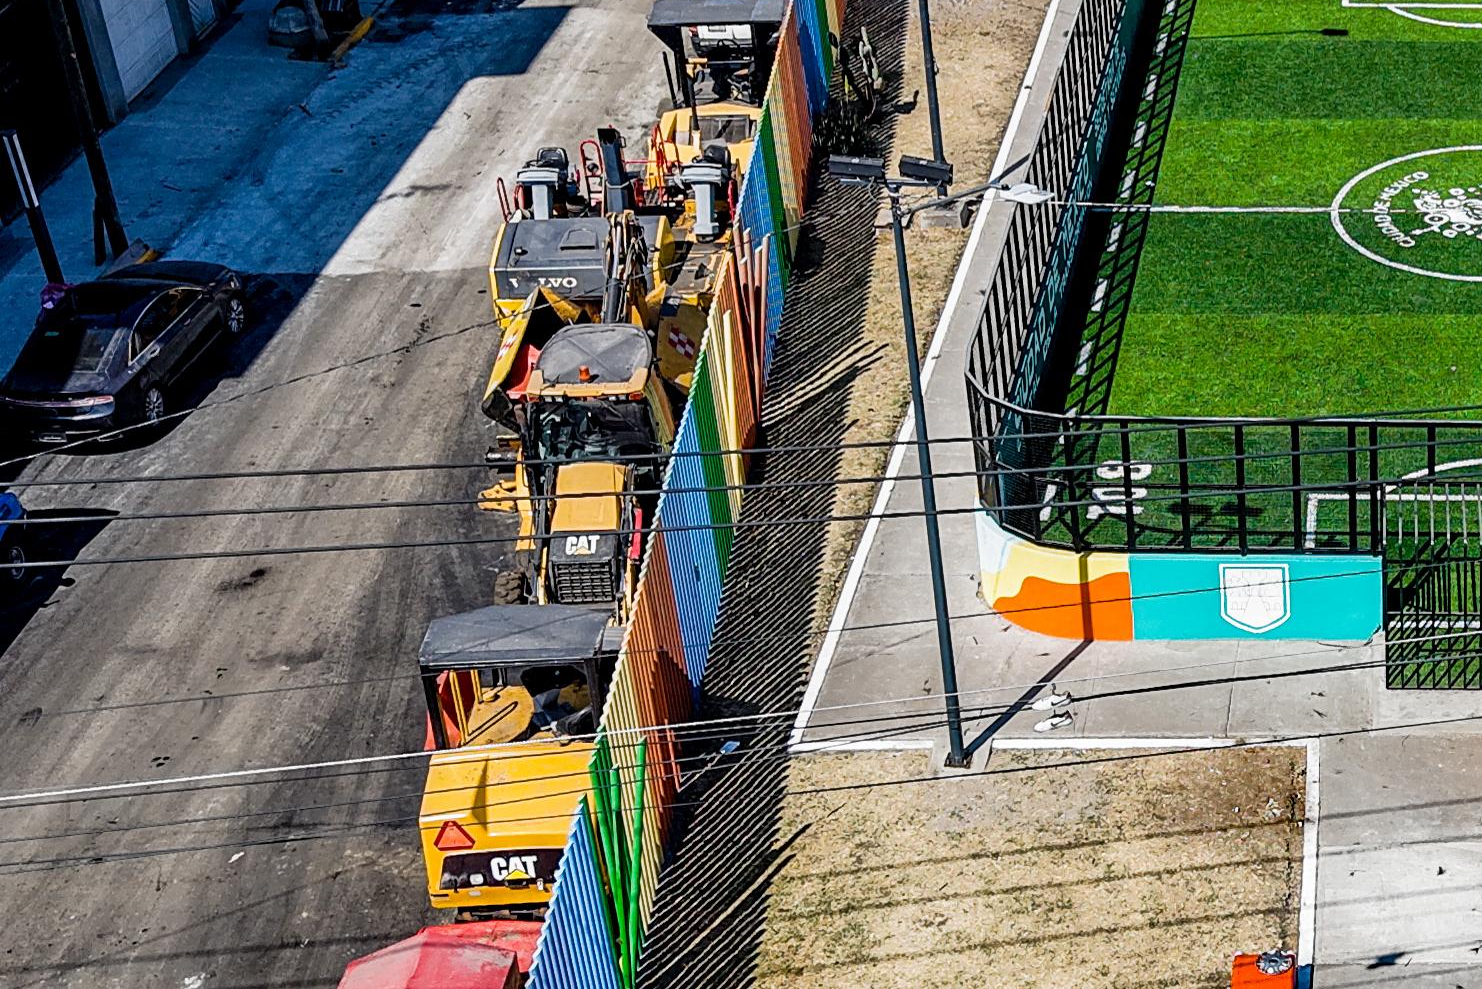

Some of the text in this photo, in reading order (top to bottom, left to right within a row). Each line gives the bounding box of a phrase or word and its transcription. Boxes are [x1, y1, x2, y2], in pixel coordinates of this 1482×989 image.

[508, 277, 578, 289] VLVO
[565, 534, 600, 556] CAT
[490, 855, 538, 882] CAT
